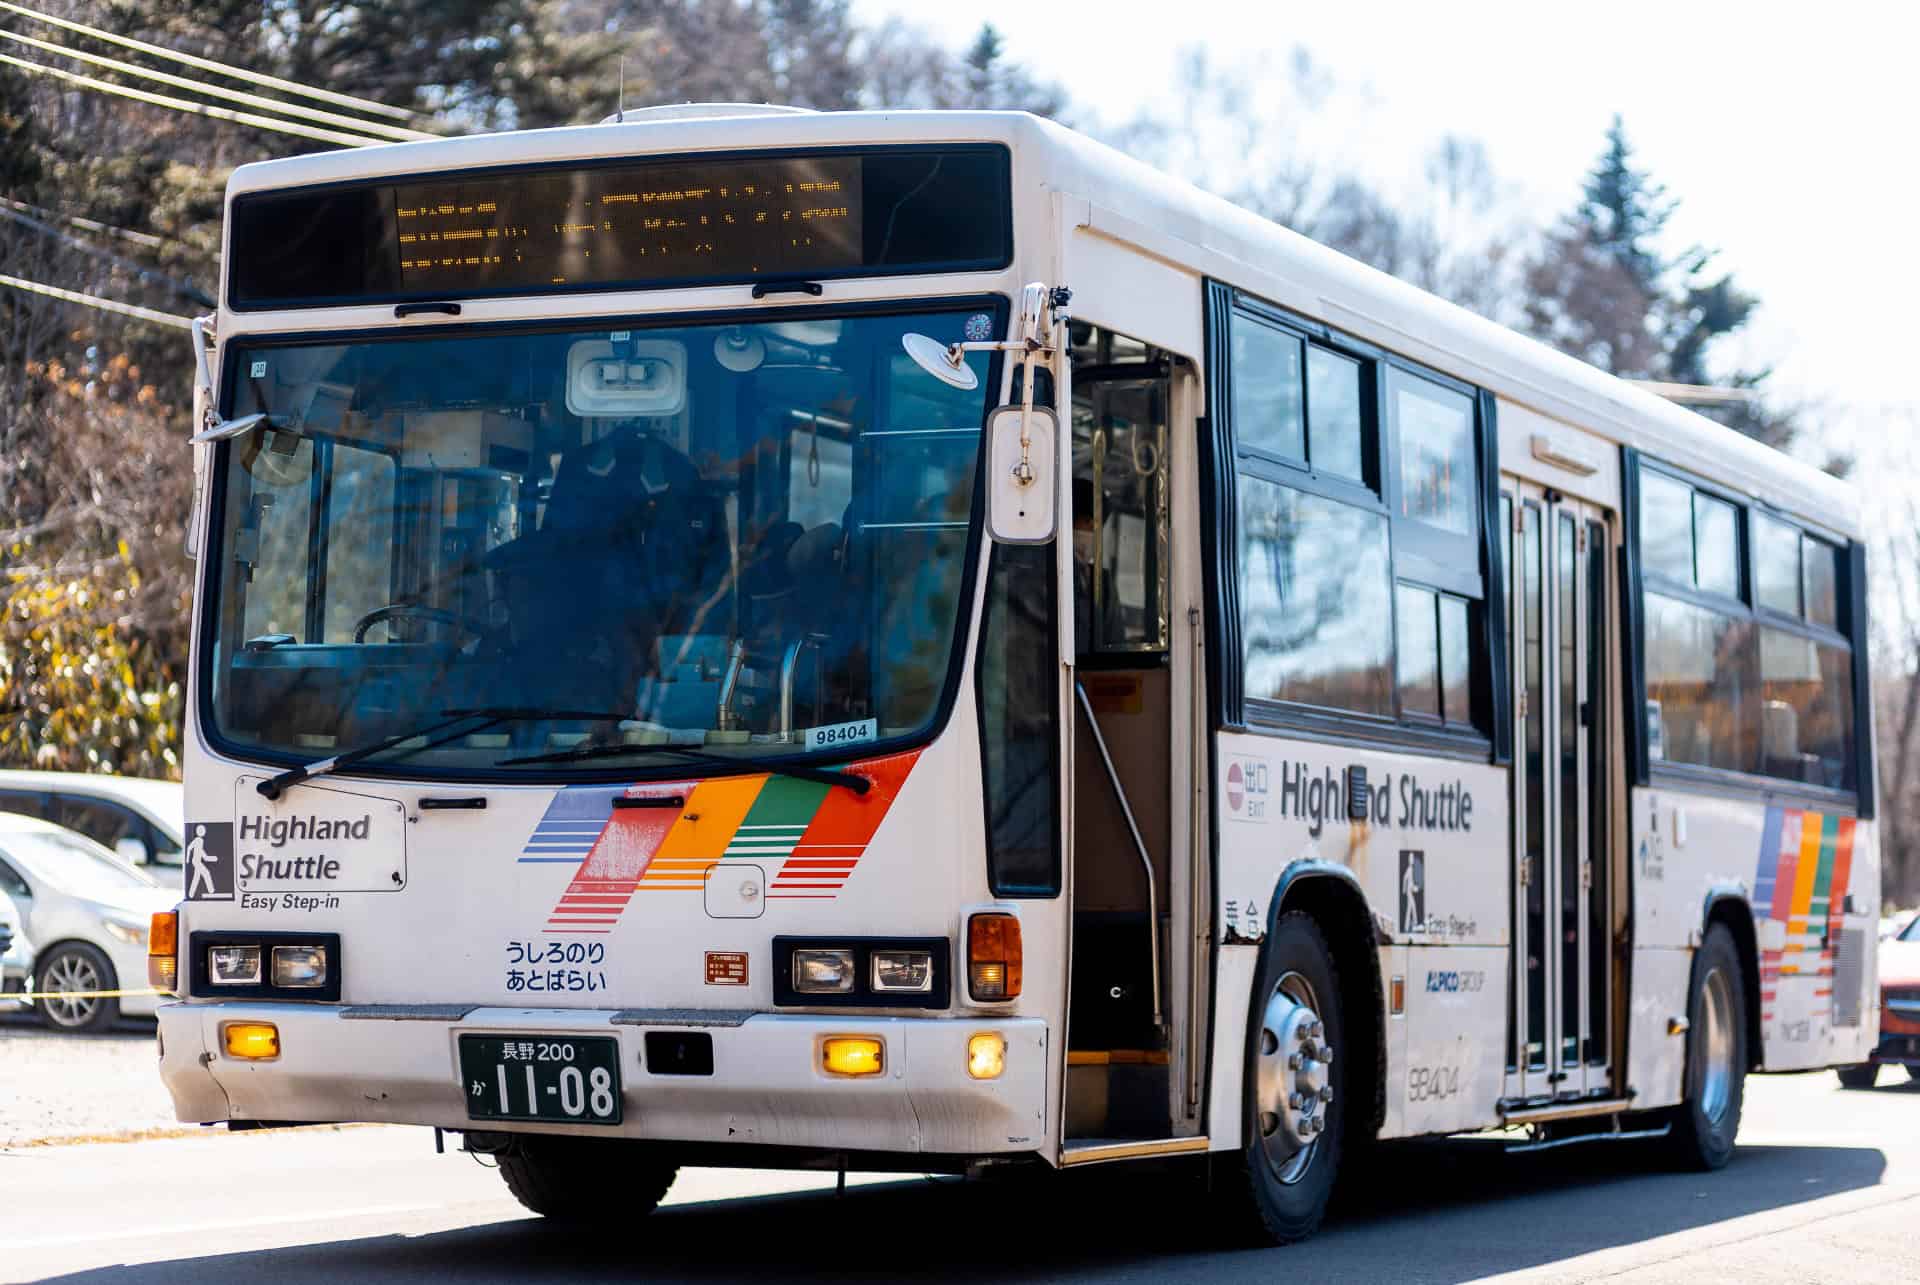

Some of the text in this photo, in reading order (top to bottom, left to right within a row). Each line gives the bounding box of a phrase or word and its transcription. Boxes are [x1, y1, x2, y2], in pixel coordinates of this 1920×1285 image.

[816, 724, 867, 745] 98404
[1245, 761, 1267, 793] 出口
[1248, 800, 1265, 817] EXIT
[1281, 760, 1472, 839] Highlnd Shuttle
[239, 815, 370, 848] Highland
[239, 854, 340, 880] Shuttle
[241, 893, 340, 912] Easy Step-in
[506, 941, 604, 964] うしろのり
[506, 968, 606, 991] あとばらい
[502, 1042, 575, 1061] 長野200
[471, 1064, 614, 1117] か 11-08
